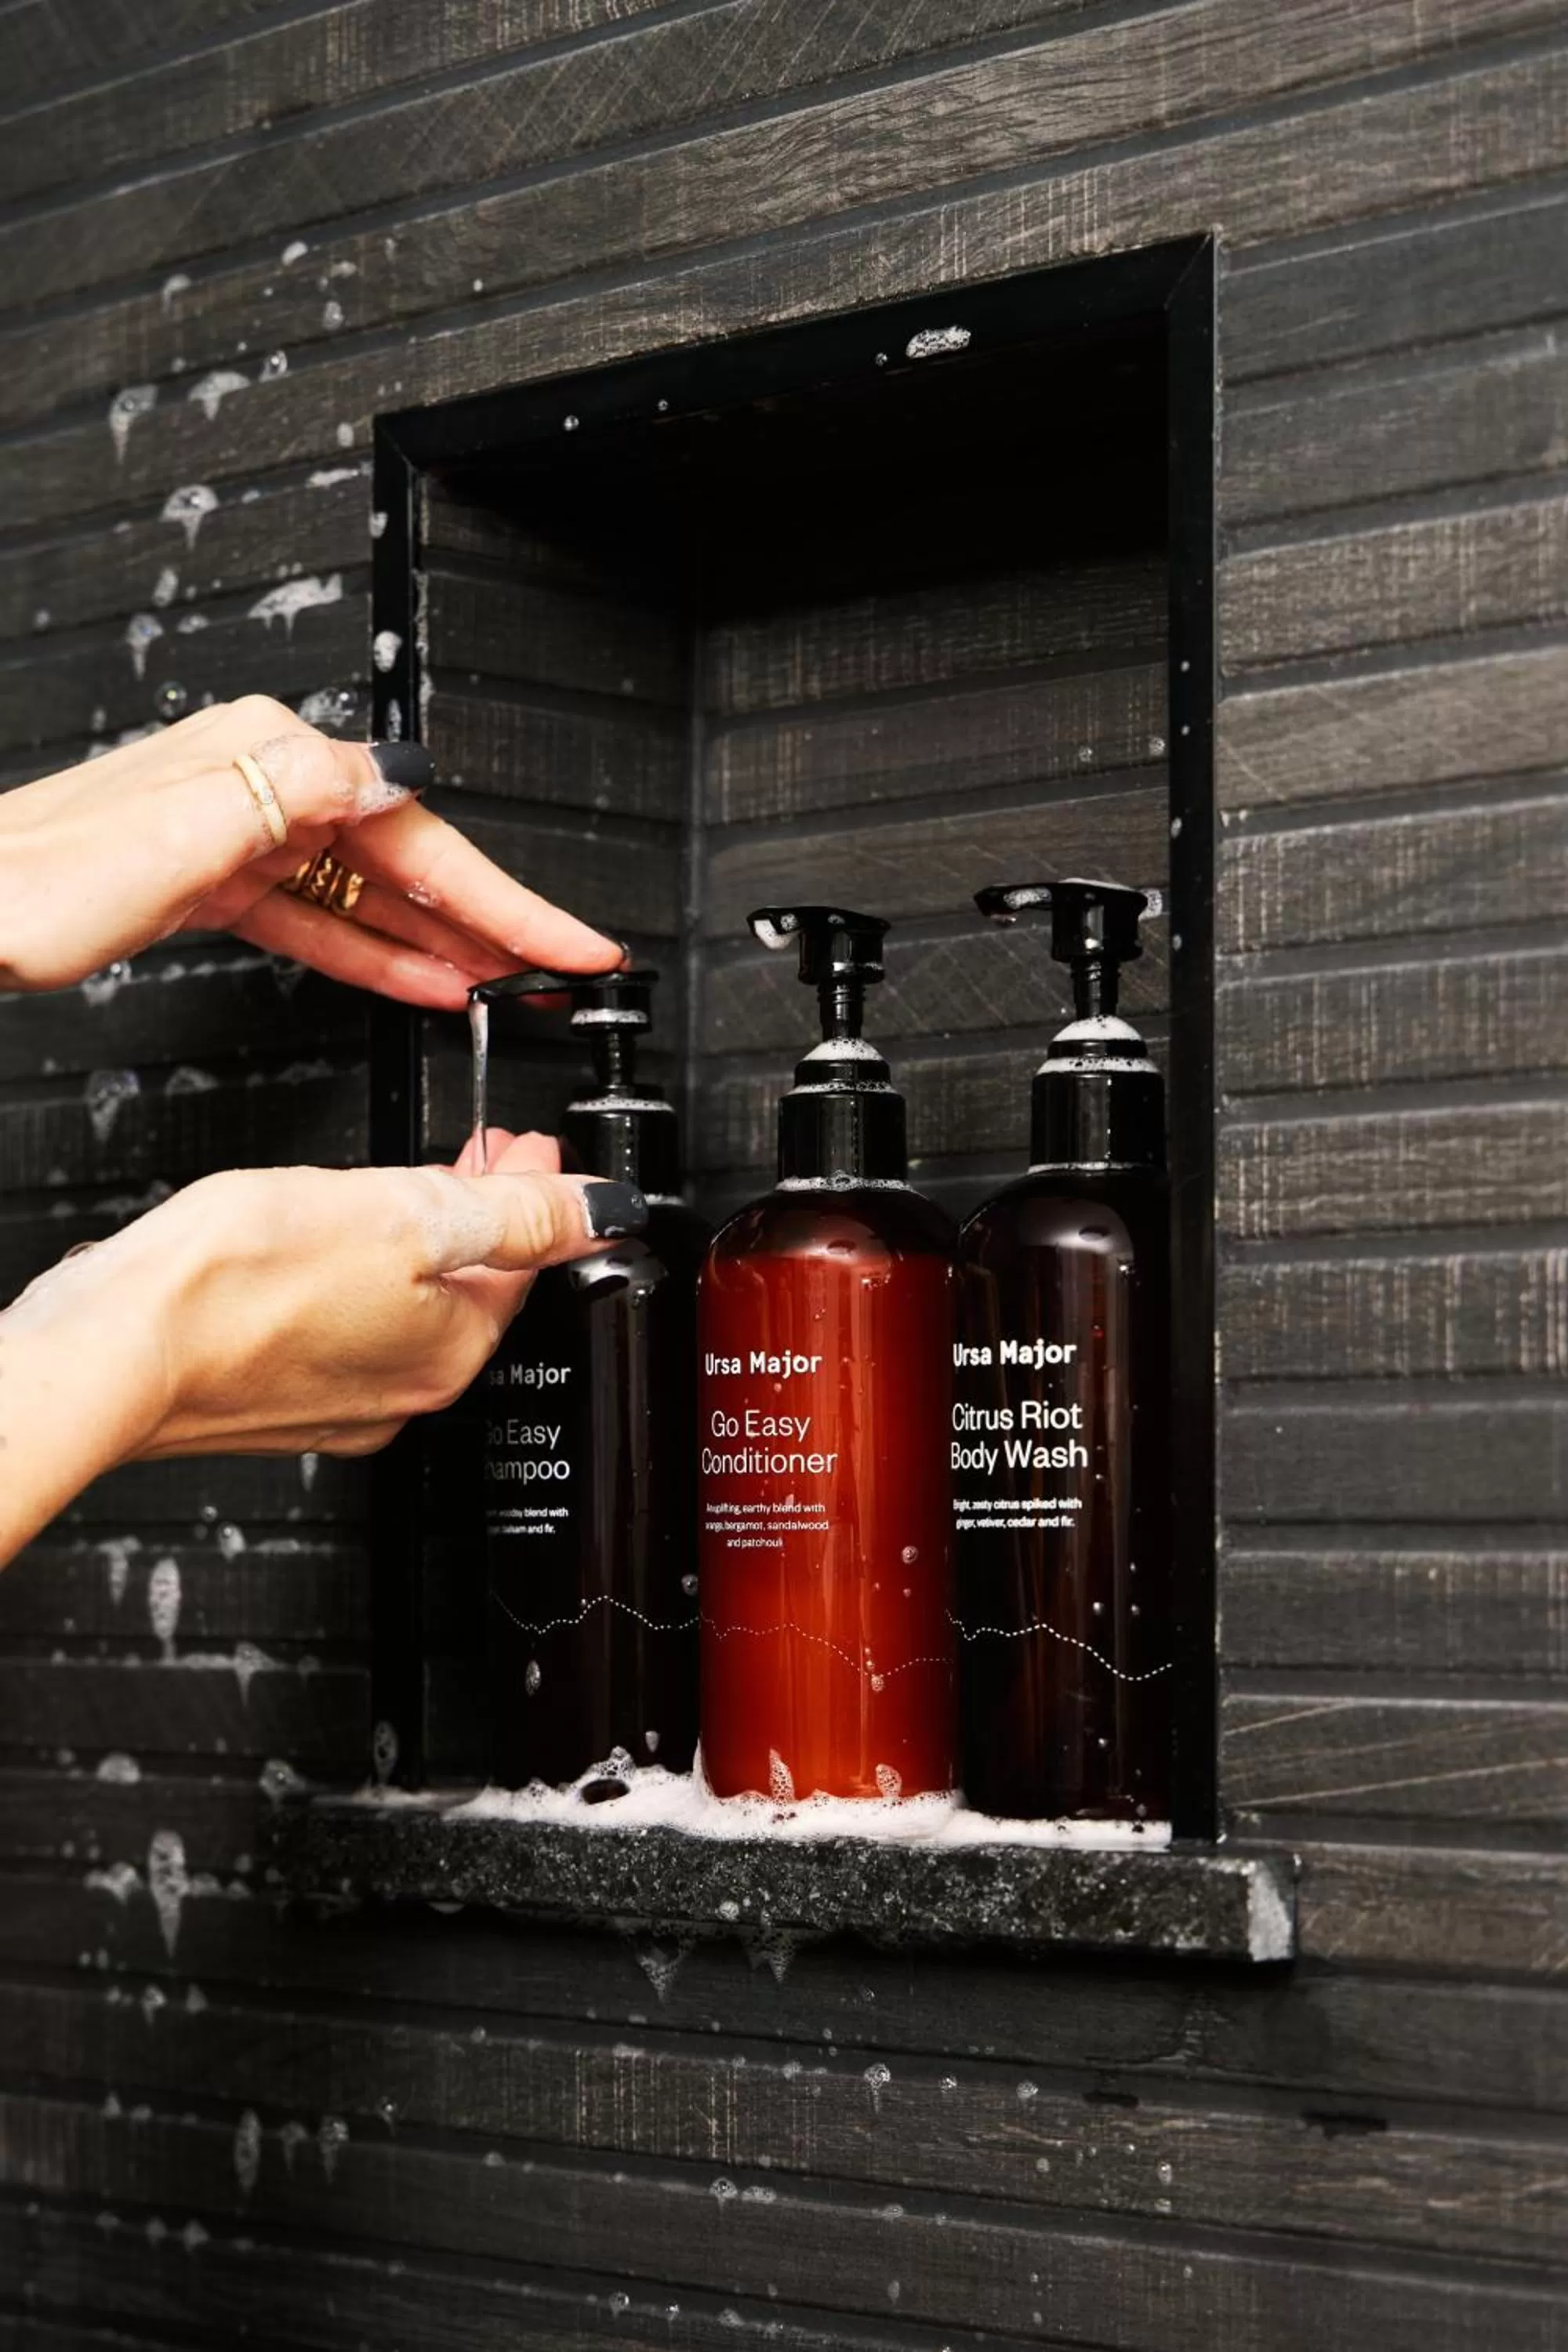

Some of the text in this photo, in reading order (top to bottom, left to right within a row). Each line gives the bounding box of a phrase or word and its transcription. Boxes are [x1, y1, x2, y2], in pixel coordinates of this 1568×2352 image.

[705, 1349, 822, 1379] Ursa Major
[953, 1338, 1077, 1370] Ursa Major
[510, 1362, 572, 1390] Major
[711, 1409, 811, 1443] Go Easy
[952, 1399, 1083, 1432] Citrus Riot
[507, 1418, 561, 1450] Easy
[484, 1456, 571, 1486] hampoo
[702, 1446, 838, 1475] Conditioner
[950, 1439, 1089, 1476] Body Wash
[524, 1507, 547, 1517] blend
[549, 1507, 568, 1517] with
[742, 1502, 771, 1515] earthy
[772, 1502, 801, 1513] blend
[803, 1502, 826, 1512] with
[993, 1499, 1019, 1509] citrus
[1021, 1497, 1057, 1512] spiked
[1058, 1497, 1082, 1509] with
[527, 1523, 543, 1534] and
[767, 1519, 829, 1530] sandalwood
[1007, 1516, 1036, 1528] cedar
[1037, 1516, 1059, 1528] and
[1061, 1515, 1076, 1527] fir.
[727, 1537, 741, 1548] and
